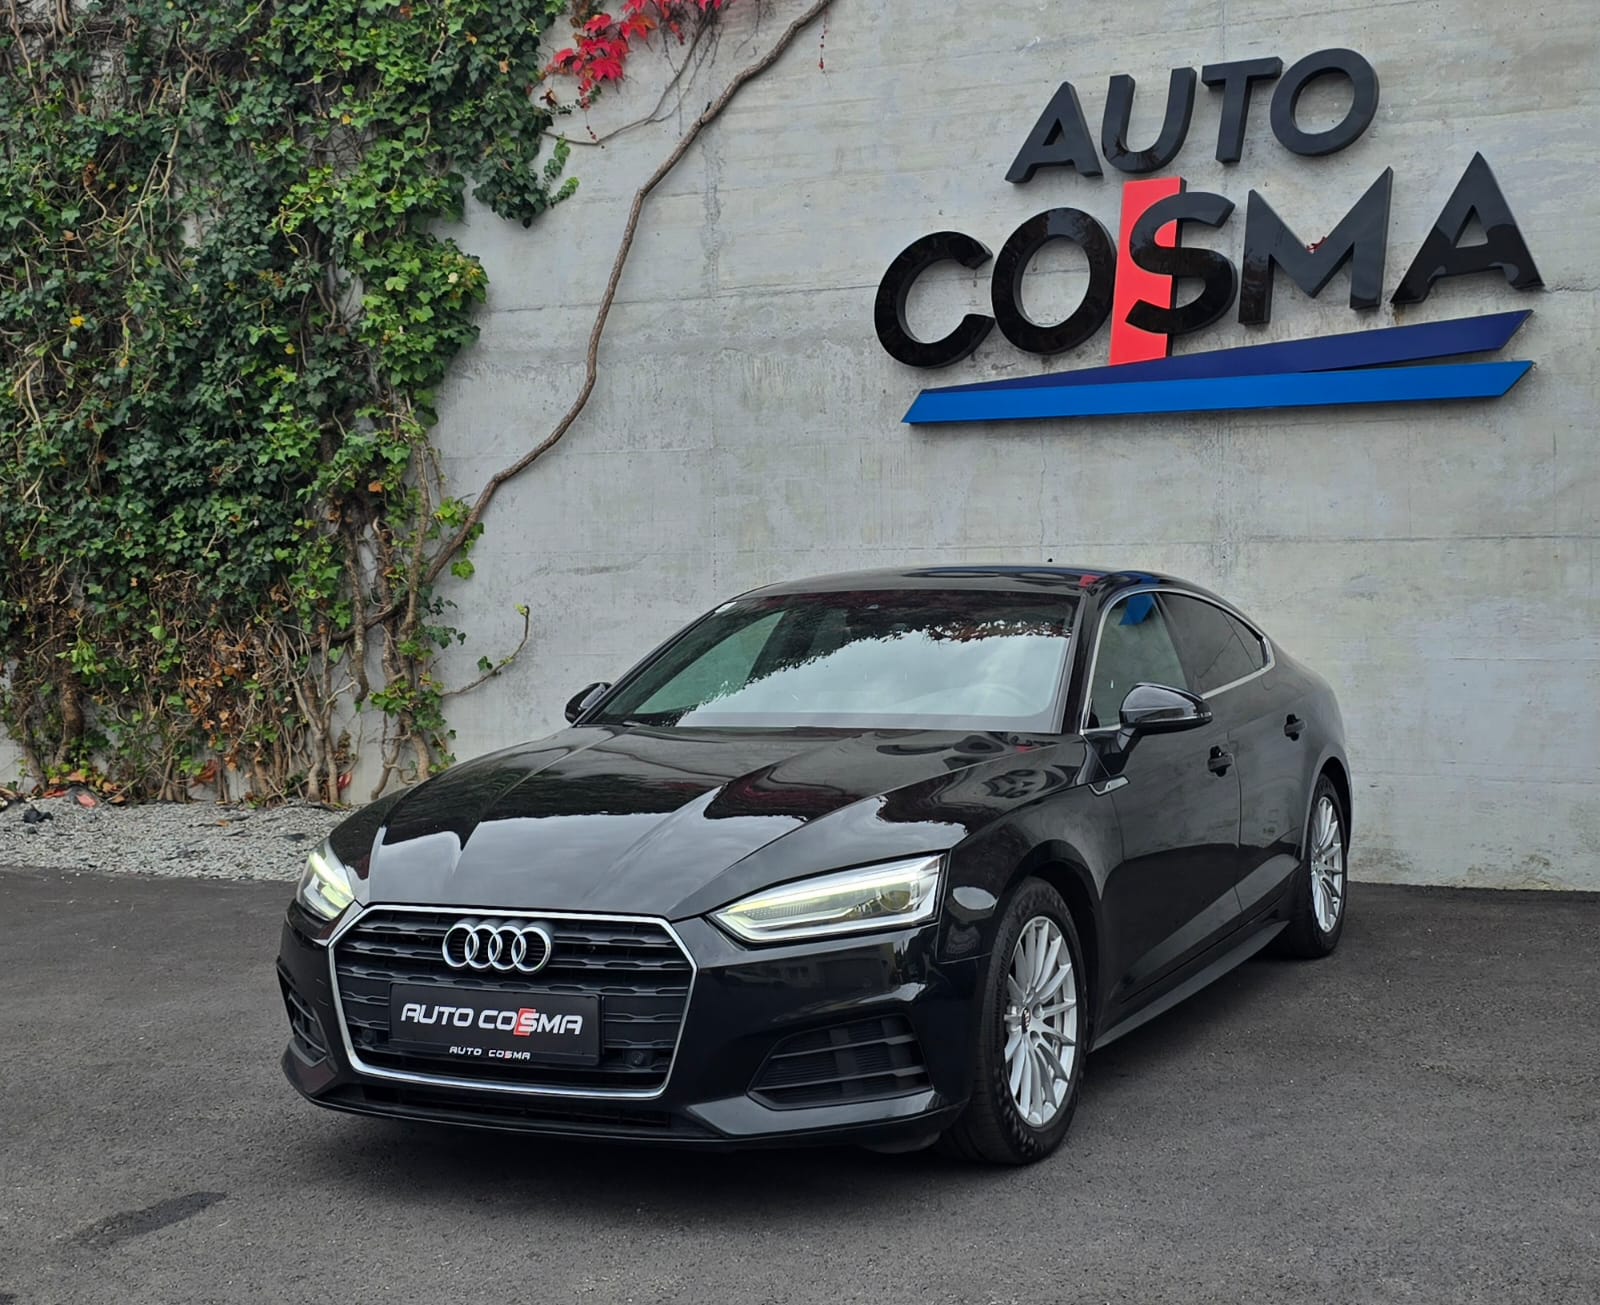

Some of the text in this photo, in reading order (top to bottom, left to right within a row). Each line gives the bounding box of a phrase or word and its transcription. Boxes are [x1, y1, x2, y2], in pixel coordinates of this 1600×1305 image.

[1004, 48, 1380, 183] AUTO
[873, 151, 1545, 369] COSMA
[400, 1003, 583, 1036] AUTO COSMA
[449, 1046, 531, 1060] AUTO COSMA
